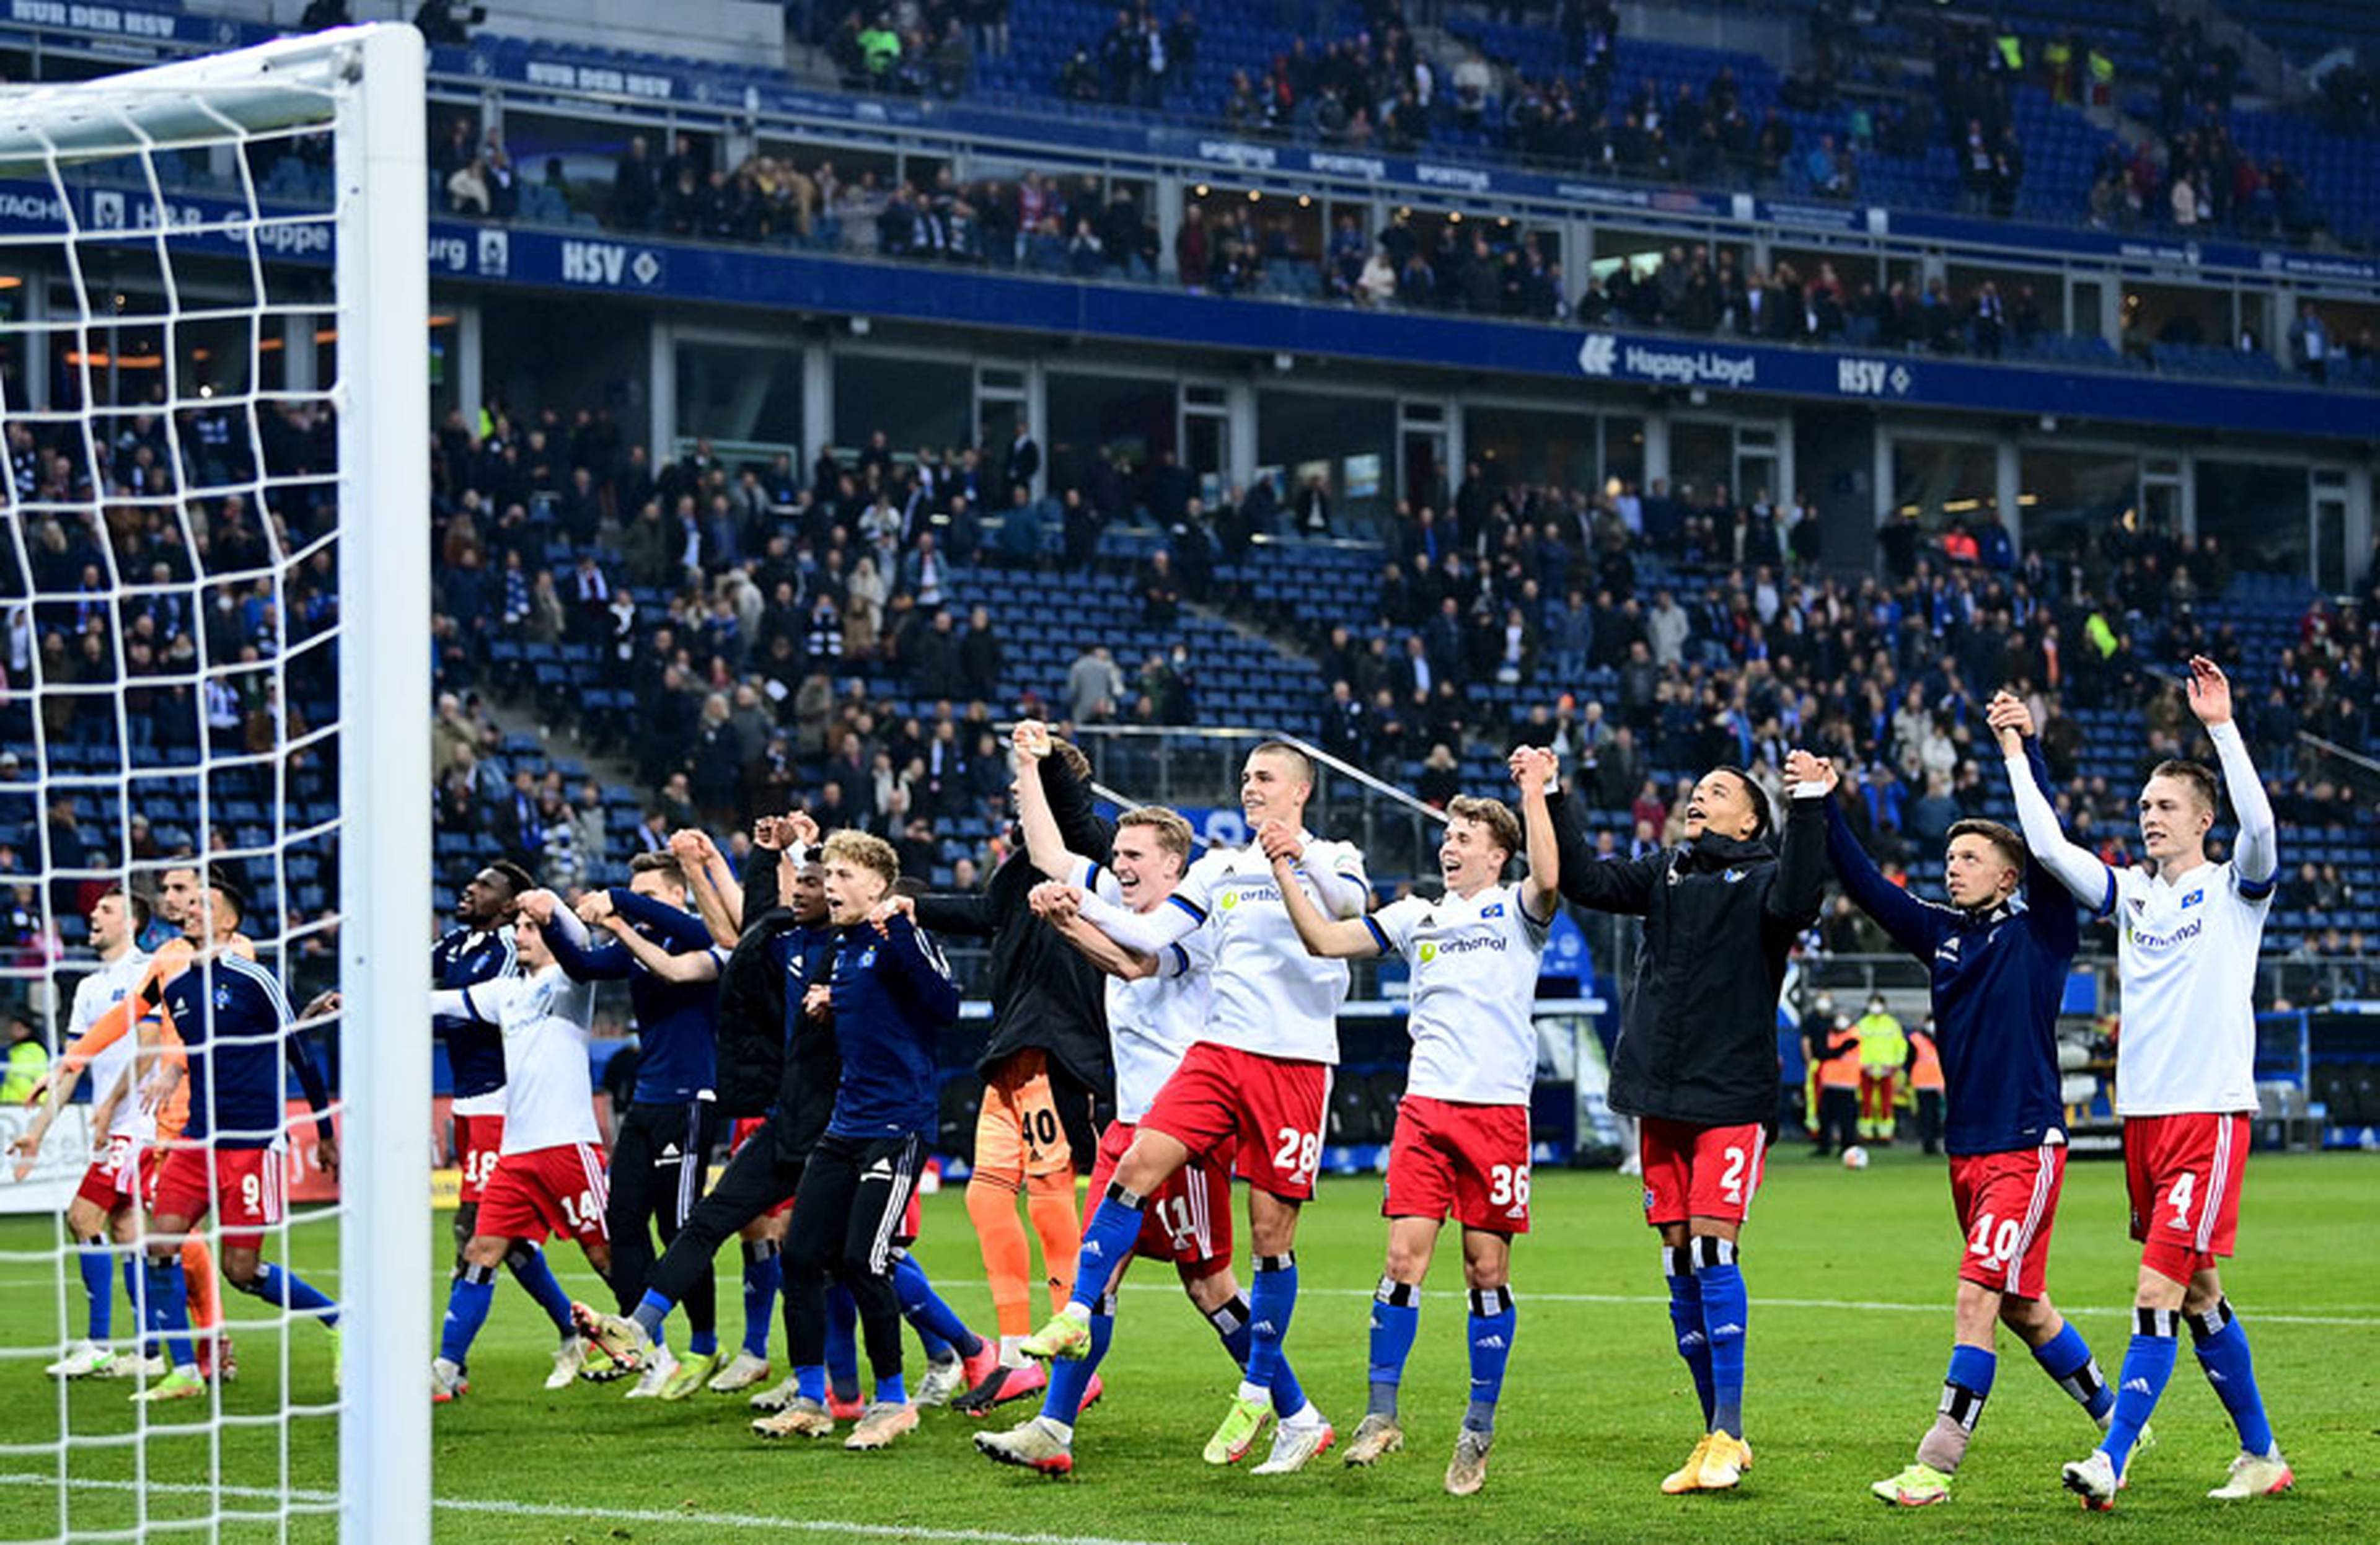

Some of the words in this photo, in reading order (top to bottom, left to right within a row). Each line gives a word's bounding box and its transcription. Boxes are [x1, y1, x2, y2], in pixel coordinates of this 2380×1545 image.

[223, 211, 330, 253] Guppe
[562, 240, 625, 285] HSV
[1625, 345, 1755, 388] Hapag-Lloyd
[1838, 359, 1886, 395] HSV
[1023, 1108, 1057, 1147] 40
[1273, 1127, 1318, 1173] 28
[1719, 1147, 1745, 1189] 2
[242, 1174, 260, 1205] 9
[1490, 1164, 1530, 1205] 36
[2168, 1171, 2197, 1215] 4
[562, 1190, 599, 1226] 14
[1156, 1196, 1197, 1238] 11
[1970, 1213, 2020, 1262] 10
